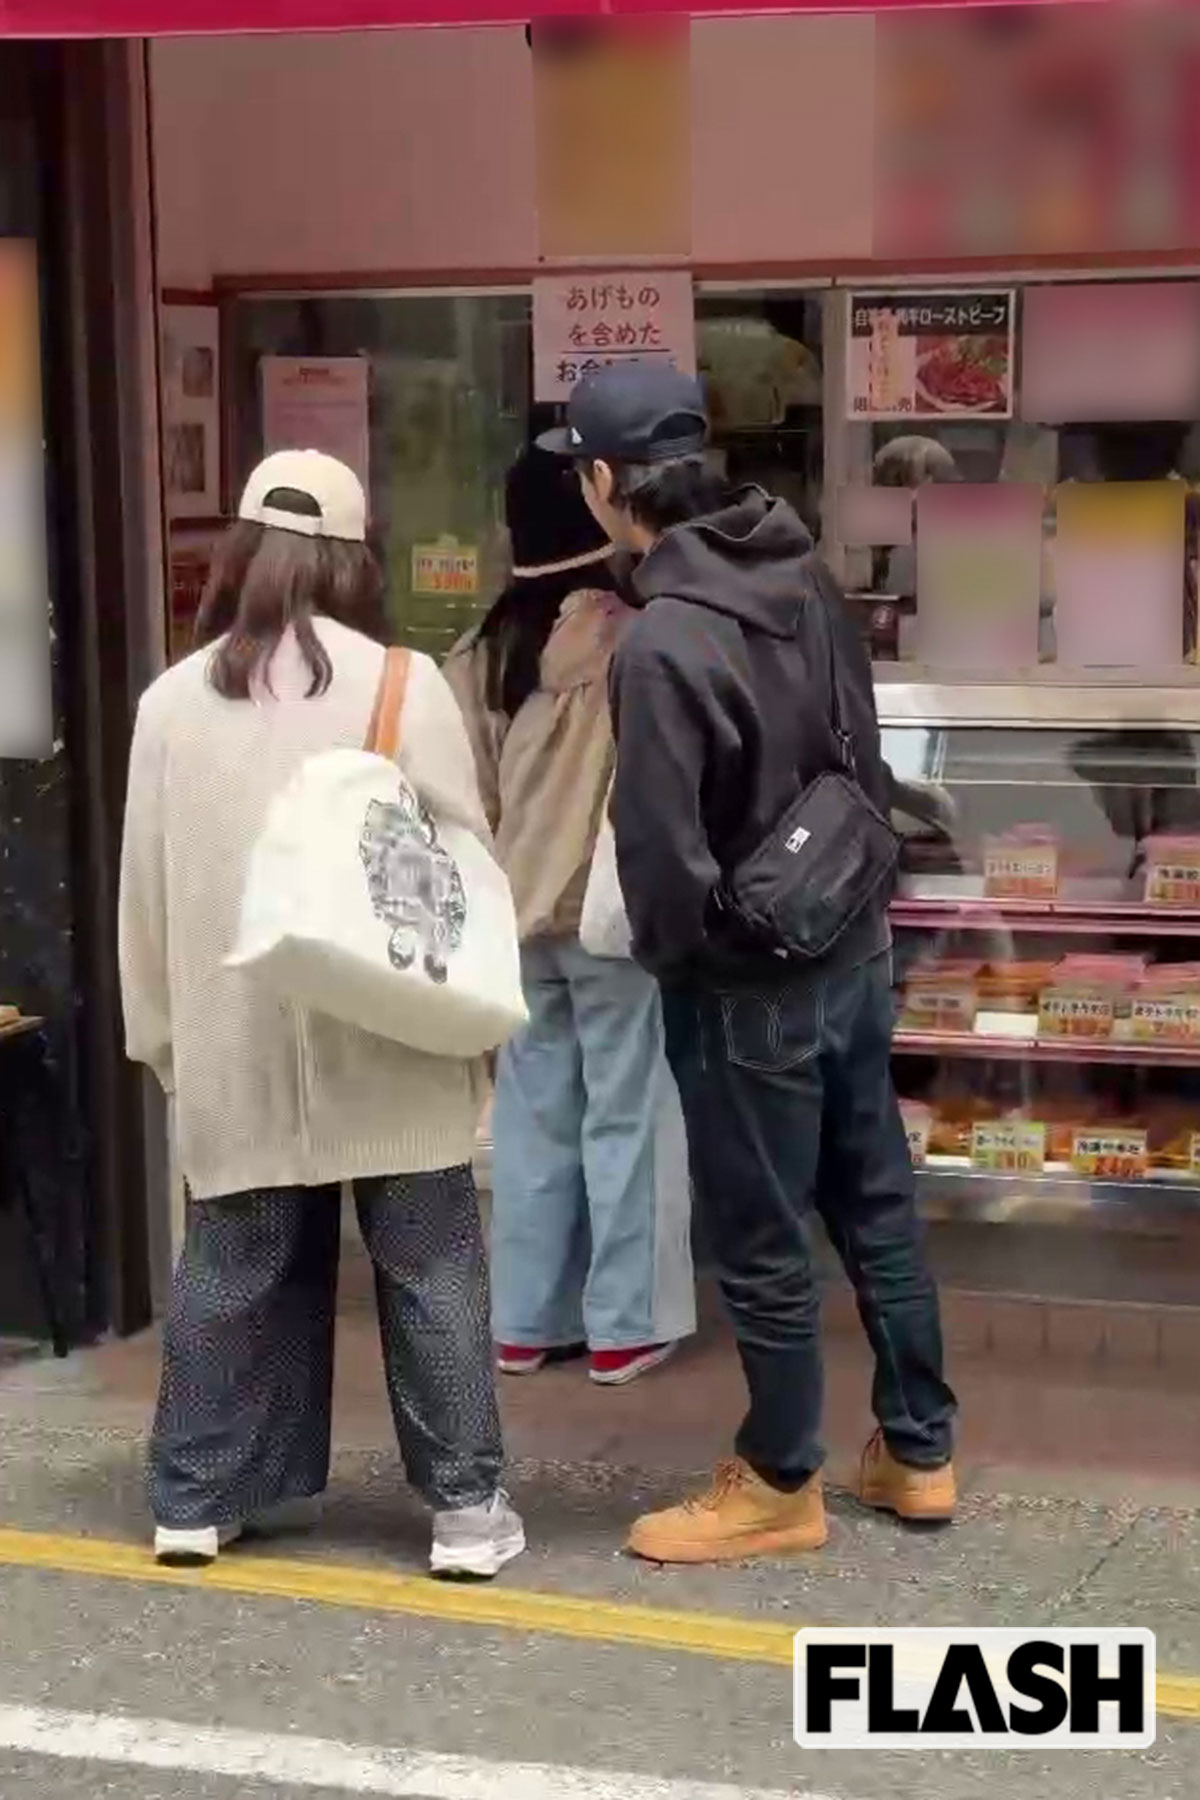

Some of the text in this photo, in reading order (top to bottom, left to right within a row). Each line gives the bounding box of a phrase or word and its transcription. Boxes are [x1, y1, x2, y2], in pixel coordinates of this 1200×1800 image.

[566, 283, 660, 311] あげもの
[568, 321, 662, 346] を含めた
